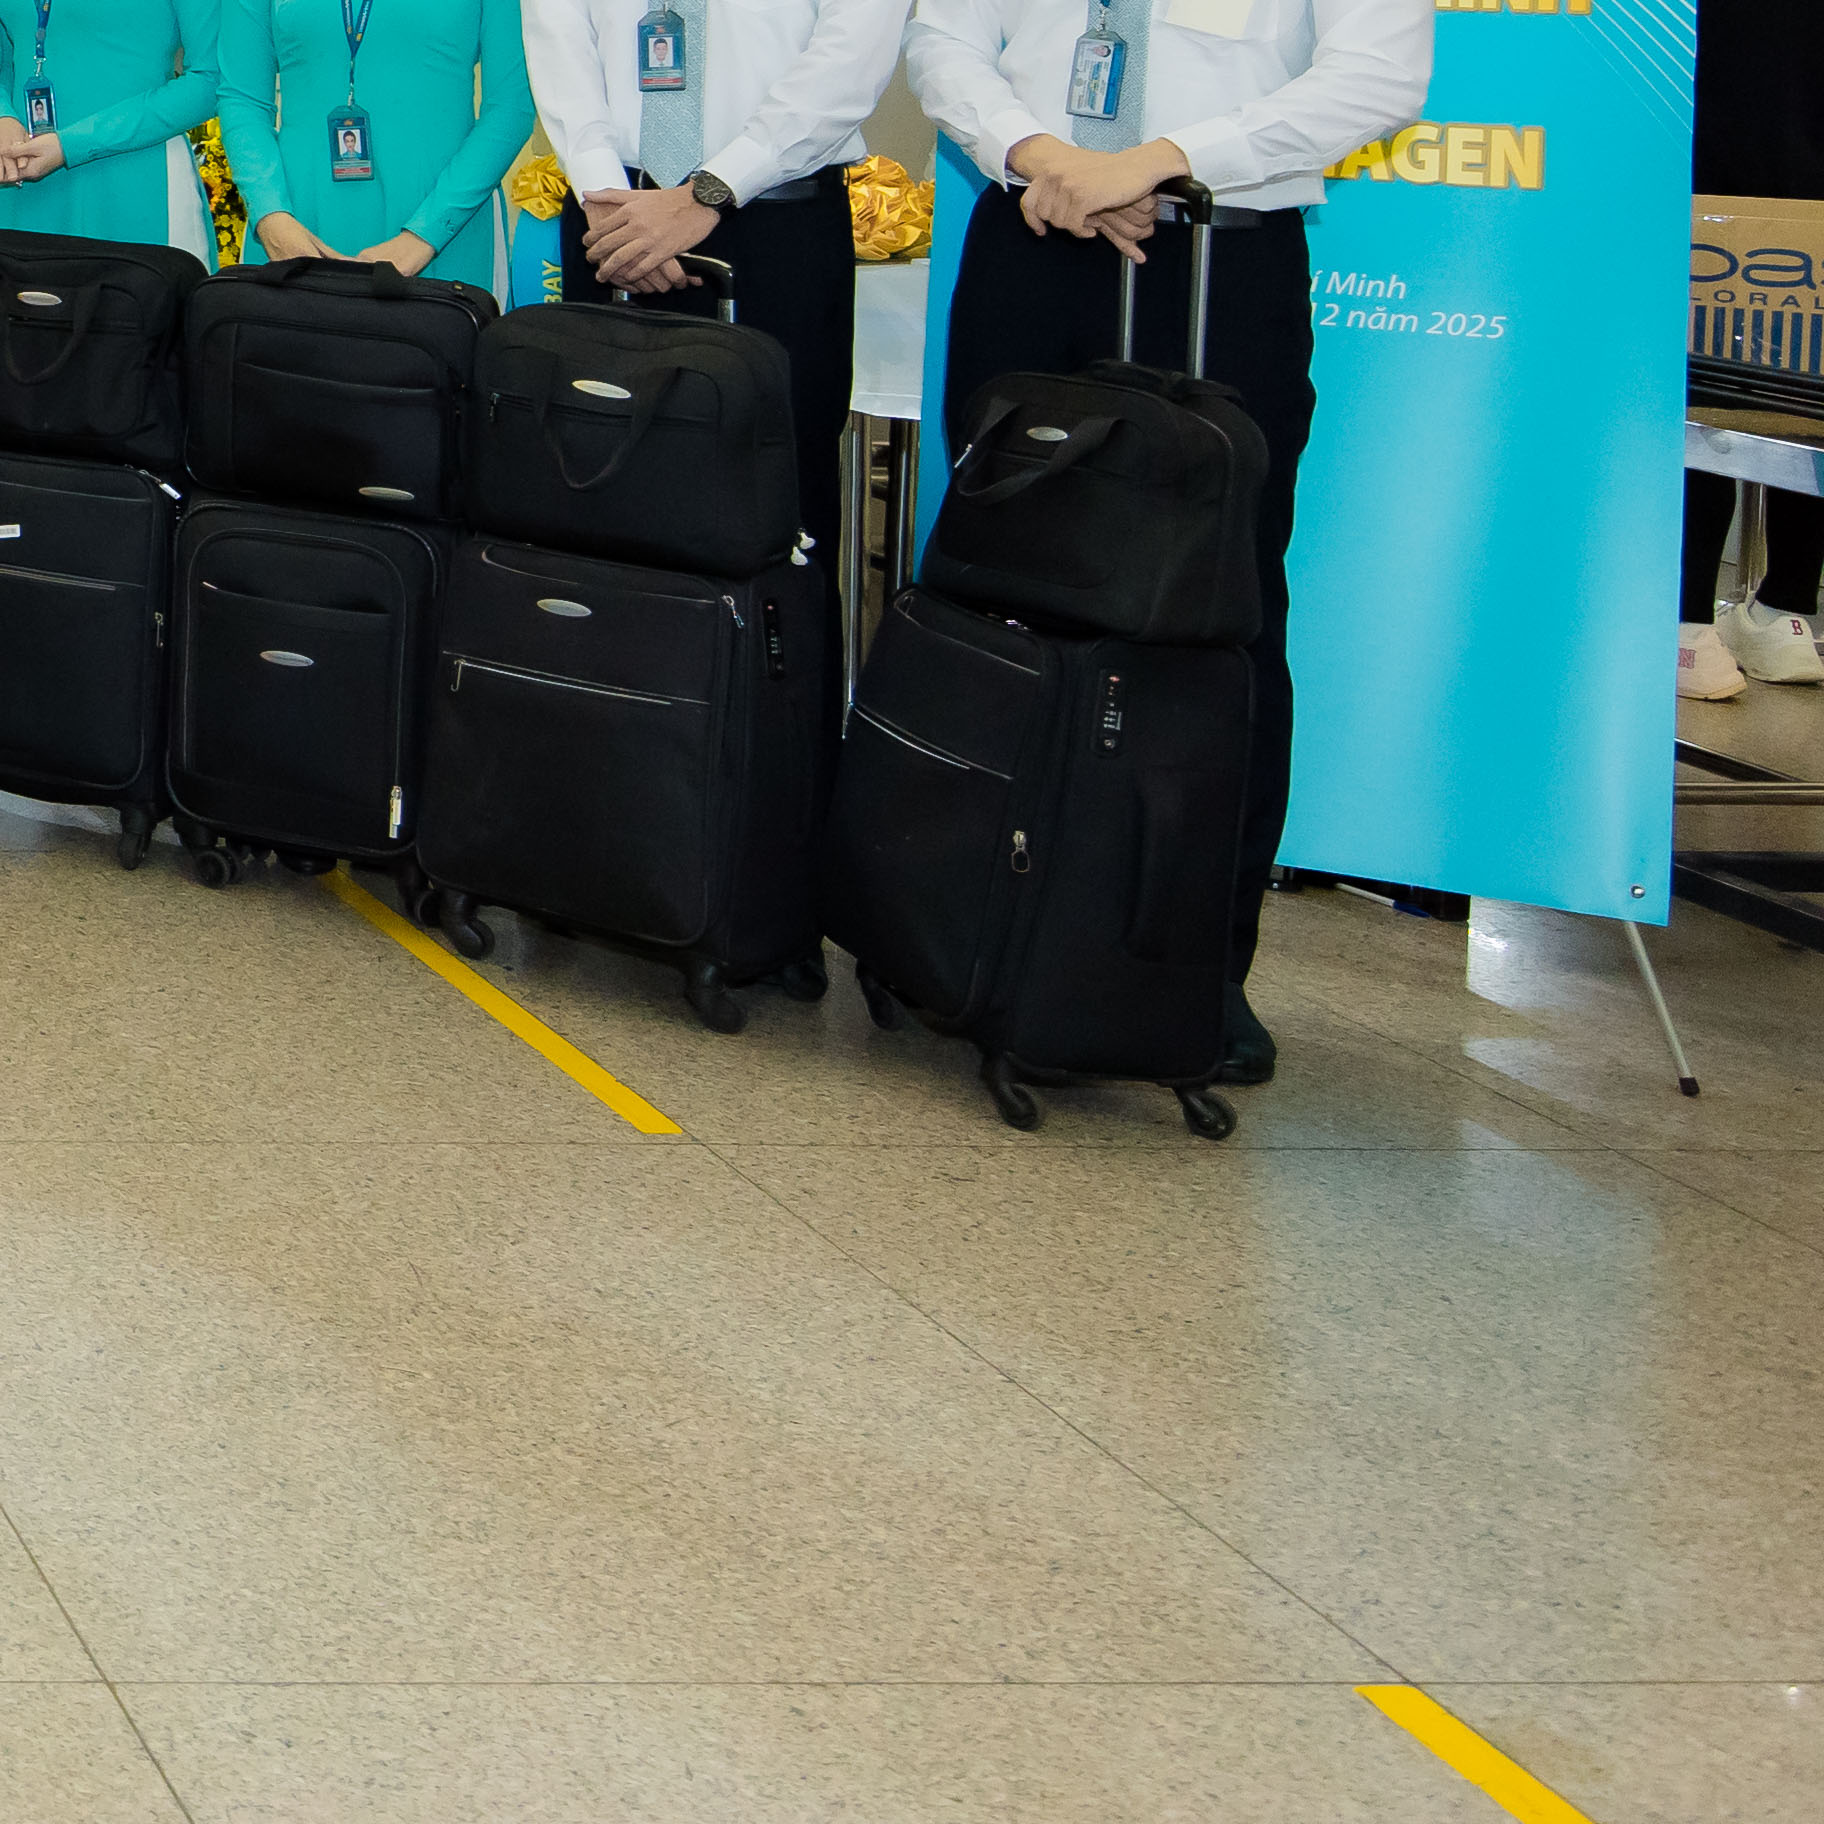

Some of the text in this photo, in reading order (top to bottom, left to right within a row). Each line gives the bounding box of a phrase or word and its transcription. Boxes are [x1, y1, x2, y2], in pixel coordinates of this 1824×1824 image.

[1325, 272, 1406, 299] Minh
[1346, 306, 1418, 332] năm
[1425, 312, 1506, 339] 2025
